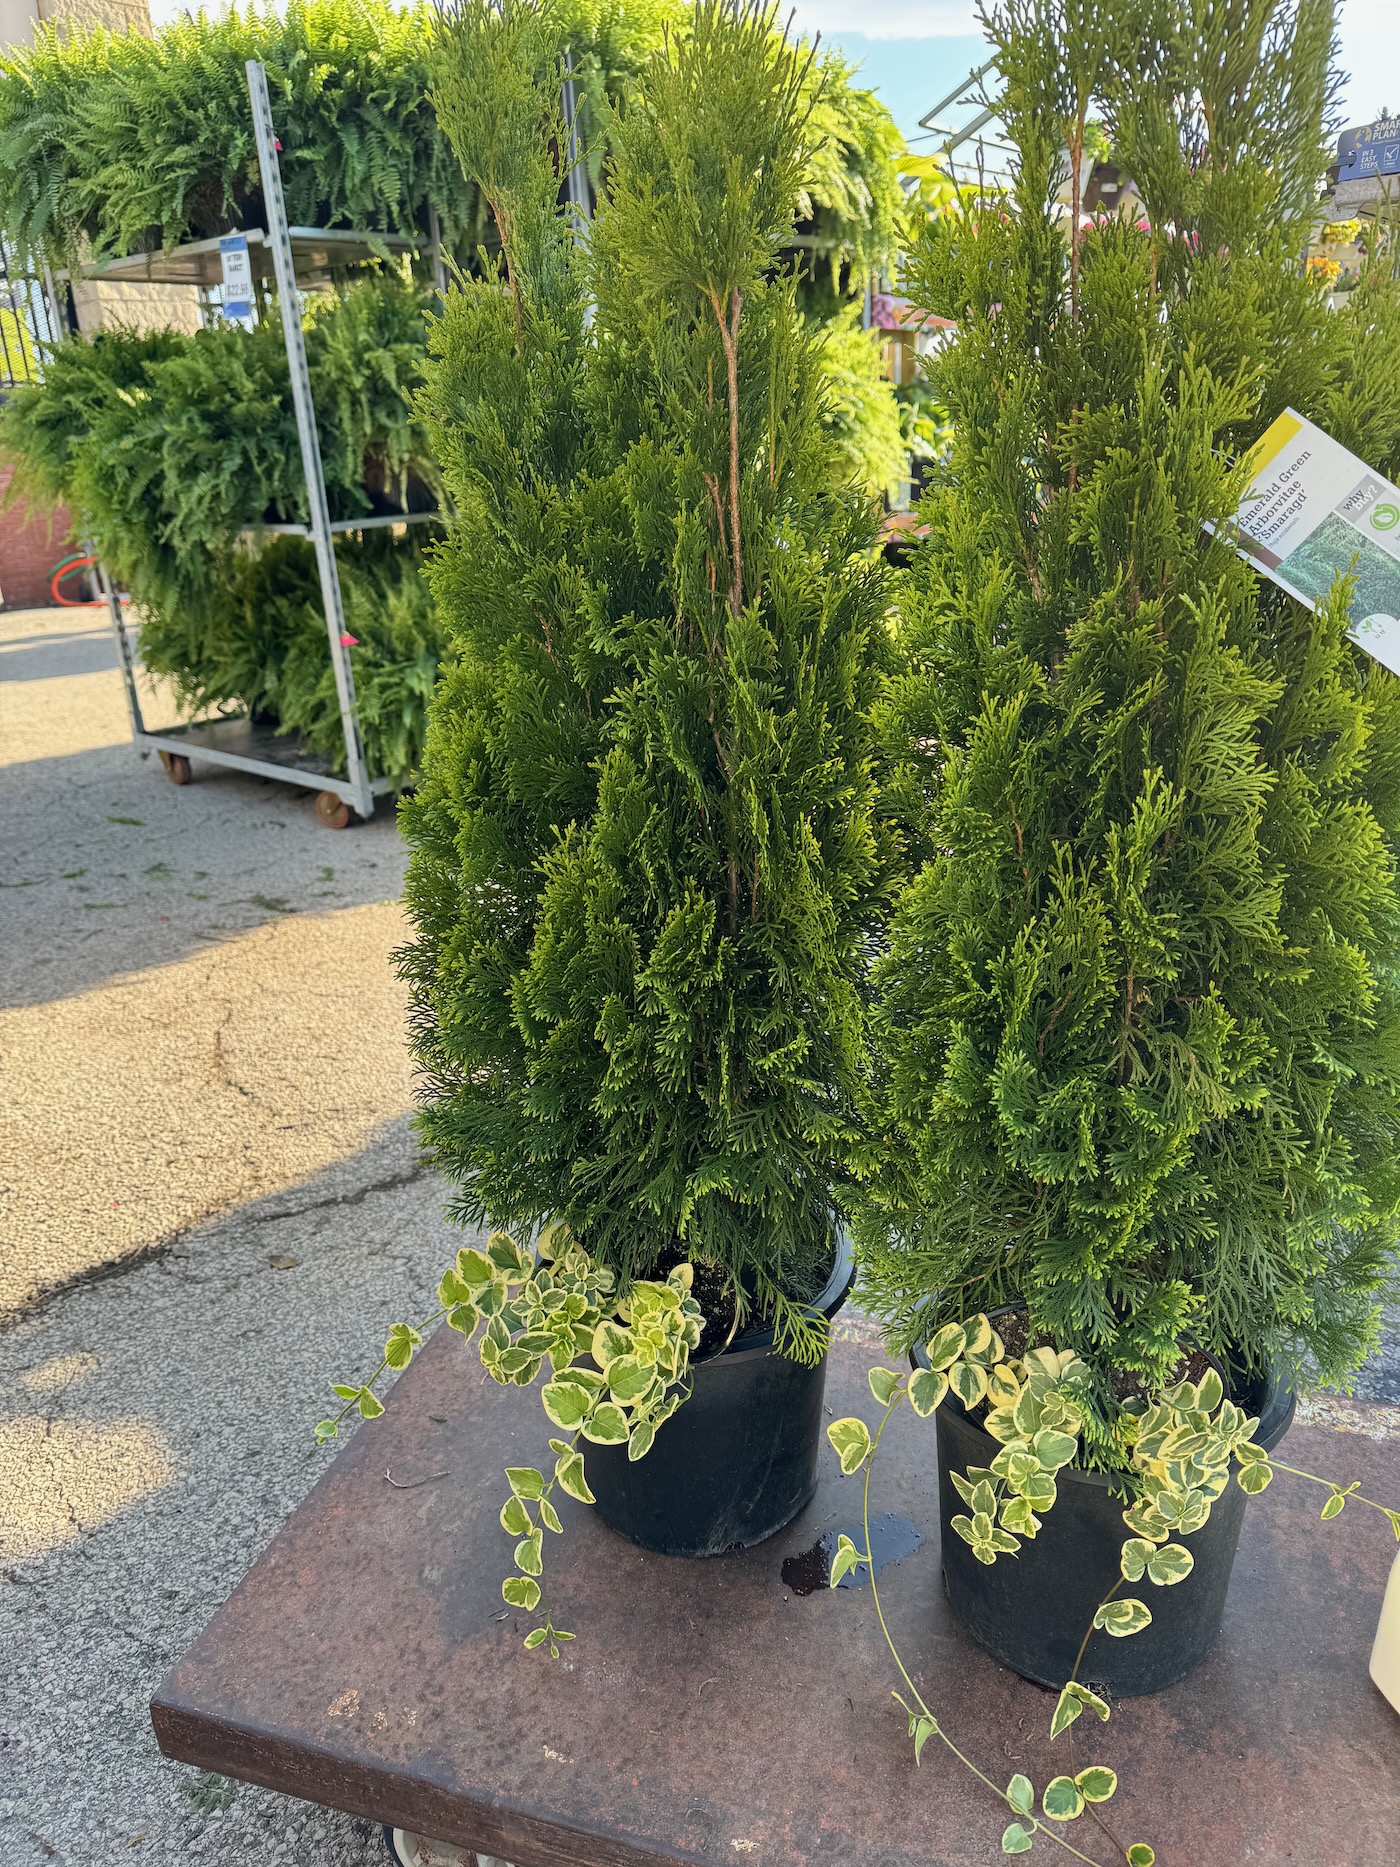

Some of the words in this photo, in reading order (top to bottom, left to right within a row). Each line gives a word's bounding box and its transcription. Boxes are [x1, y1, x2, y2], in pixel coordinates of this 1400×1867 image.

[1360, 161, 1378, 170] STEPS
[1361, 154, 1377, 163] EASY
[1239, 482, 1281, 527] Emerald
[1279, 450, 1312, 483] Green
[1343, 489, 1365, 511] why
[1354, 484, 1378, 511] buy?
[1248, 480, 1302, 536] Arborvitae
